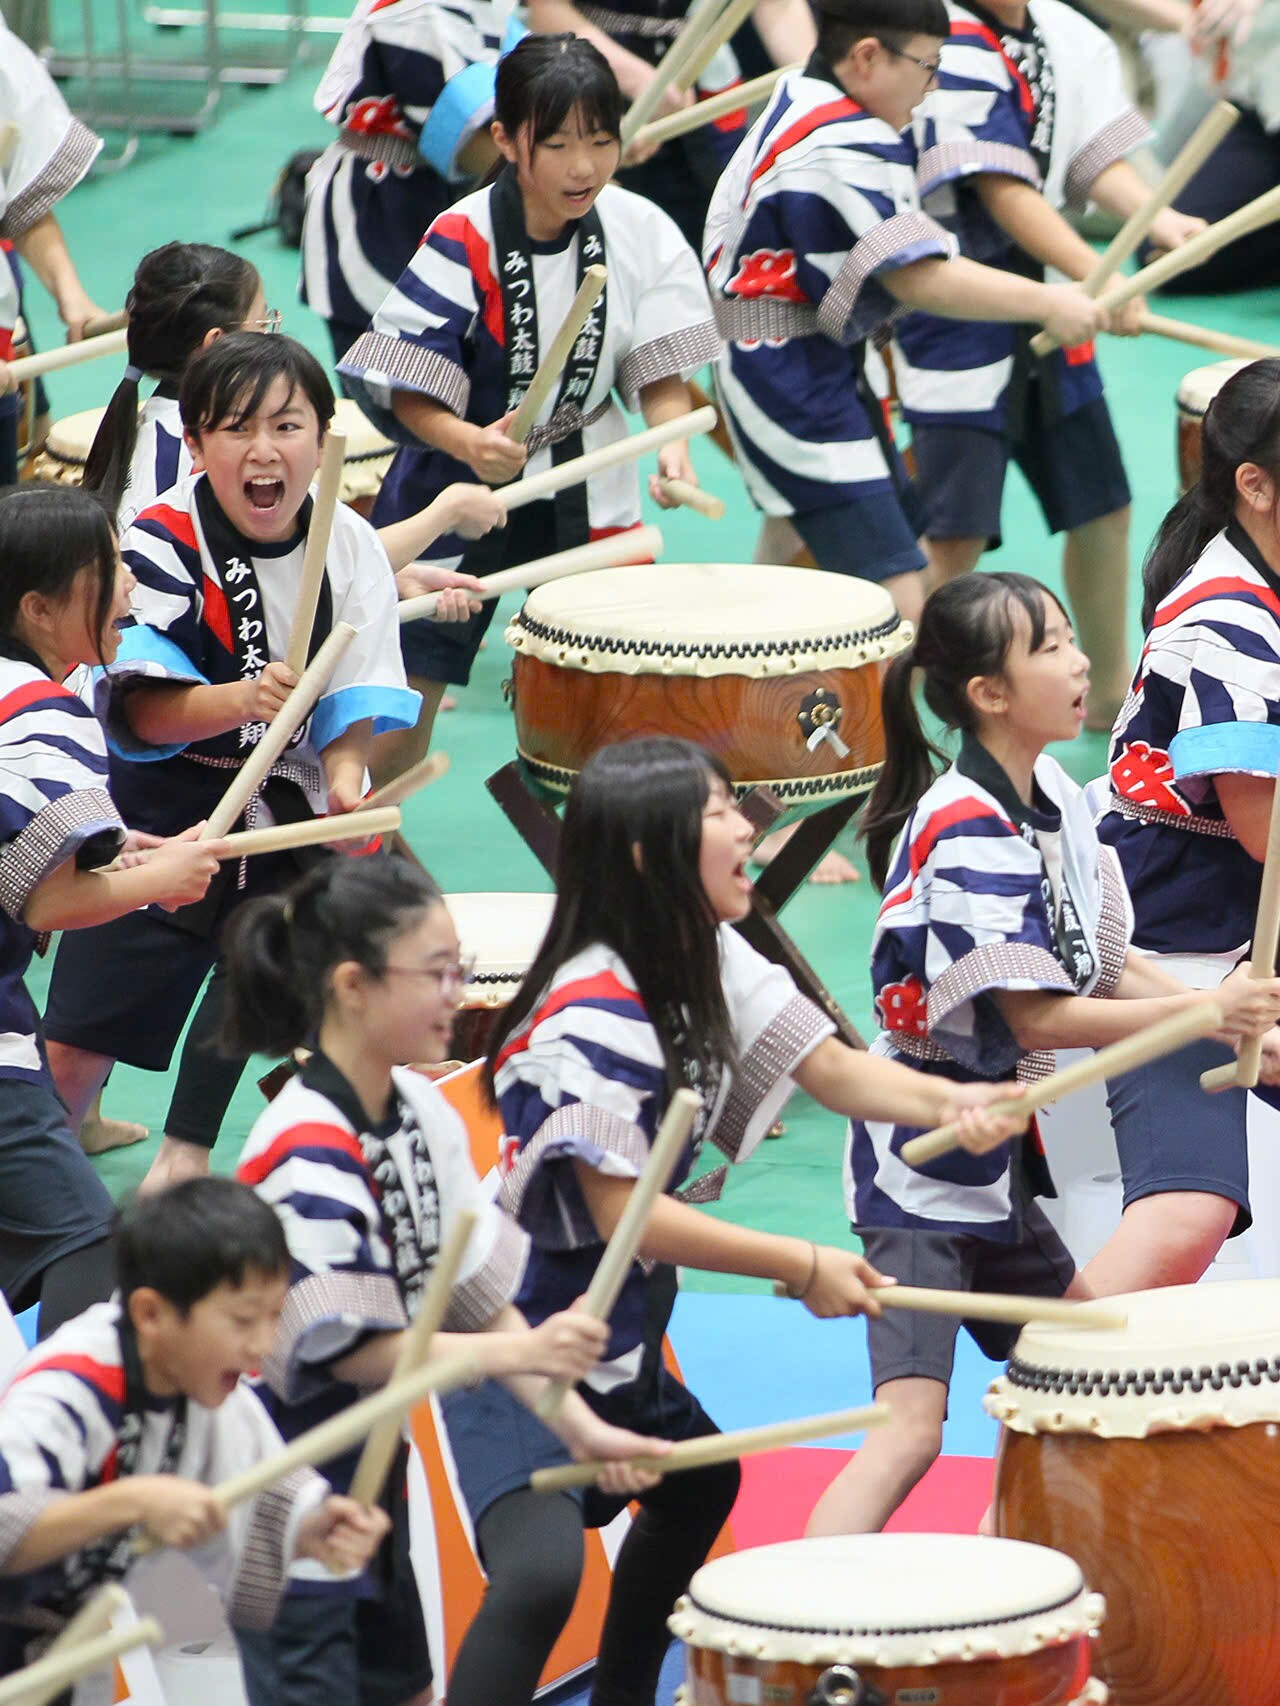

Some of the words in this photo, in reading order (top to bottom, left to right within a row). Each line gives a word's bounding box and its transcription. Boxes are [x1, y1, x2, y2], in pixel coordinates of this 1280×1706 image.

[561, 234, 603, 402] み太鼓「翔
[224, 557, 269, 749] みつわ太翔
